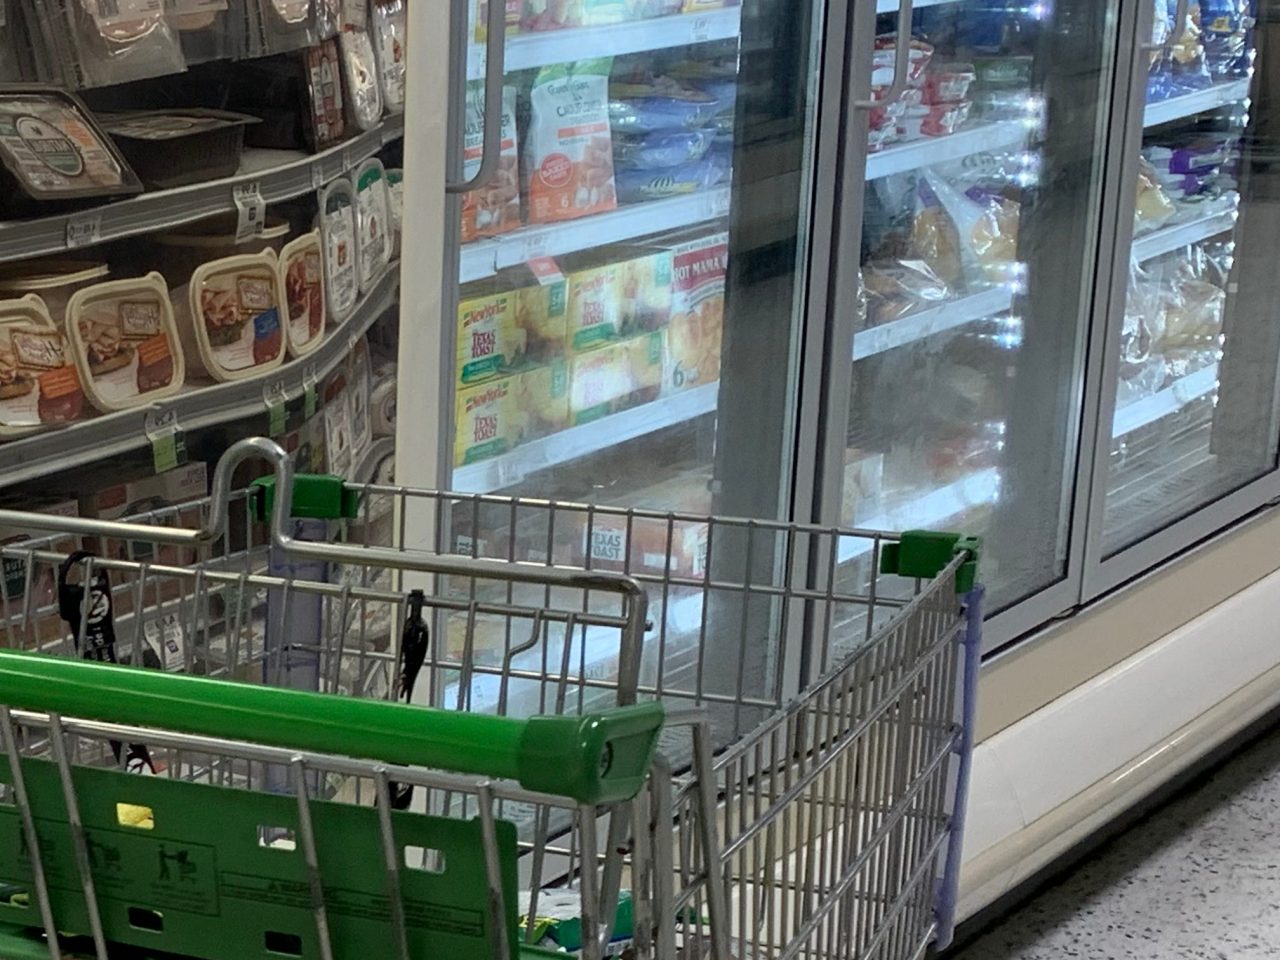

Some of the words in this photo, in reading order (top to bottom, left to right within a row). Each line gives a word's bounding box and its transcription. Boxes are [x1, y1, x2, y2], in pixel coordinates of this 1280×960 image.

[472, 331, 496, 344] TEXAS
[472, 342, 495, 358] TOAST
[673, 360, 685, 387] 6
[474, 415, 497, 428] TEXAS
[474, 427, 497, 442] TOAST
[592, 546, 621, 559] OAST
